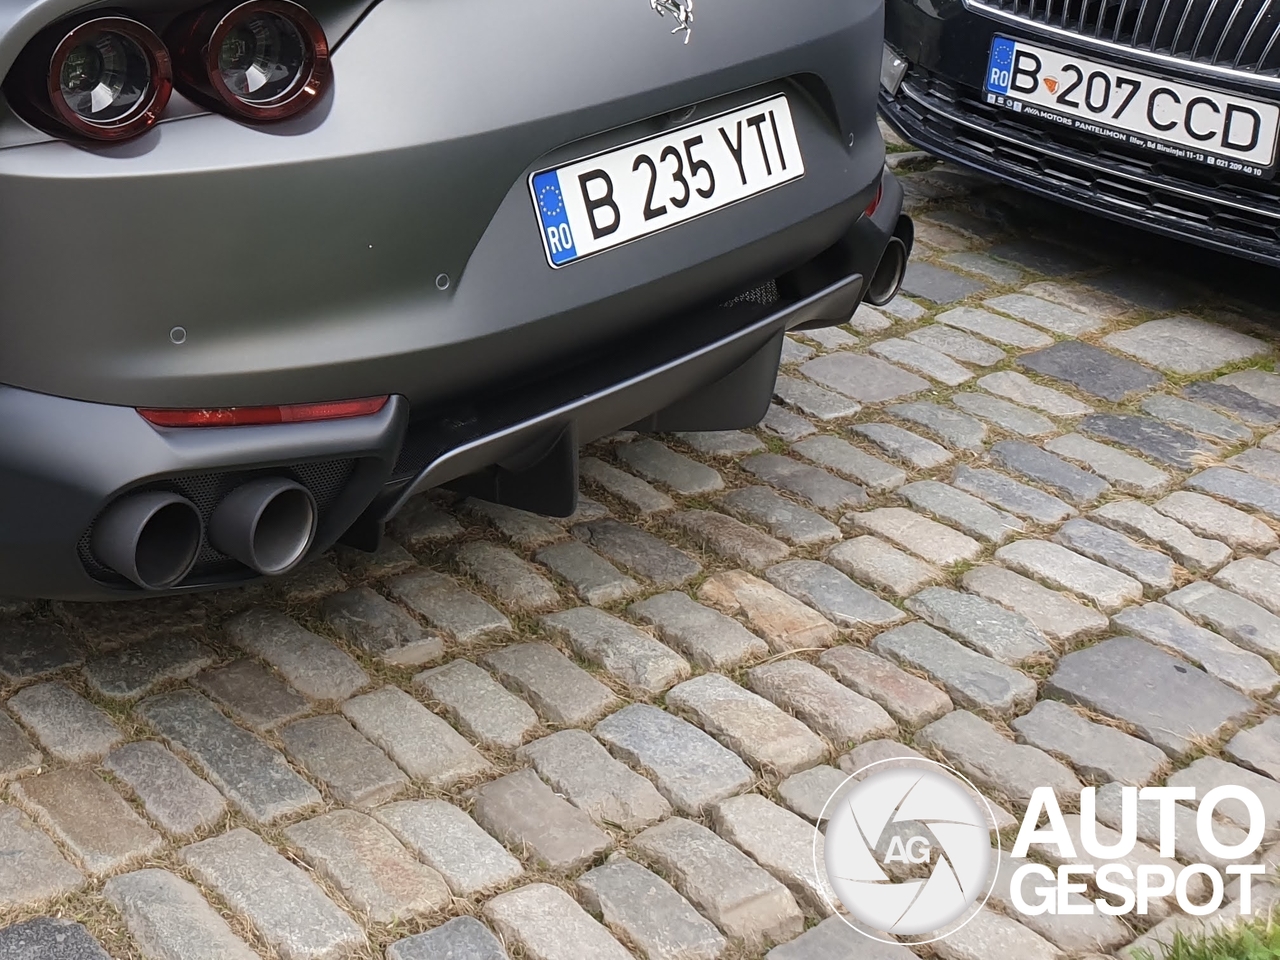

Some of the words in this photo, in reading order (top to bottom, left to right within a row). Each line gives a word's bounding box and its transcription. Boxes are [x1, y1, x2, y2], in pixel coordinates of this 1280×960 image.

[990, 68, 1009, 87] RO
[1009, 49, 1042, 94] B
[1056, 64, 1142, 119] 207
[1147, 87, 1261, 152] CCD
[578, 168, 621, 240] B
[632, 135, 716, 222] 235
[718, 109, 787, 186] YTI
[1040, 112, 1073, 126] MOTORS
[1075, 121, 1127, 141] PANTELIMON
[1186, 151, 1205, 162] 11-13
[1216, 159, 1228, 168] 021
[1229, 162, 1242, 172] 209
[1243, 165, 1253, 174] 40
[1253, 168, 1262, 177] 10
[547, 222, 573, 254] RO
